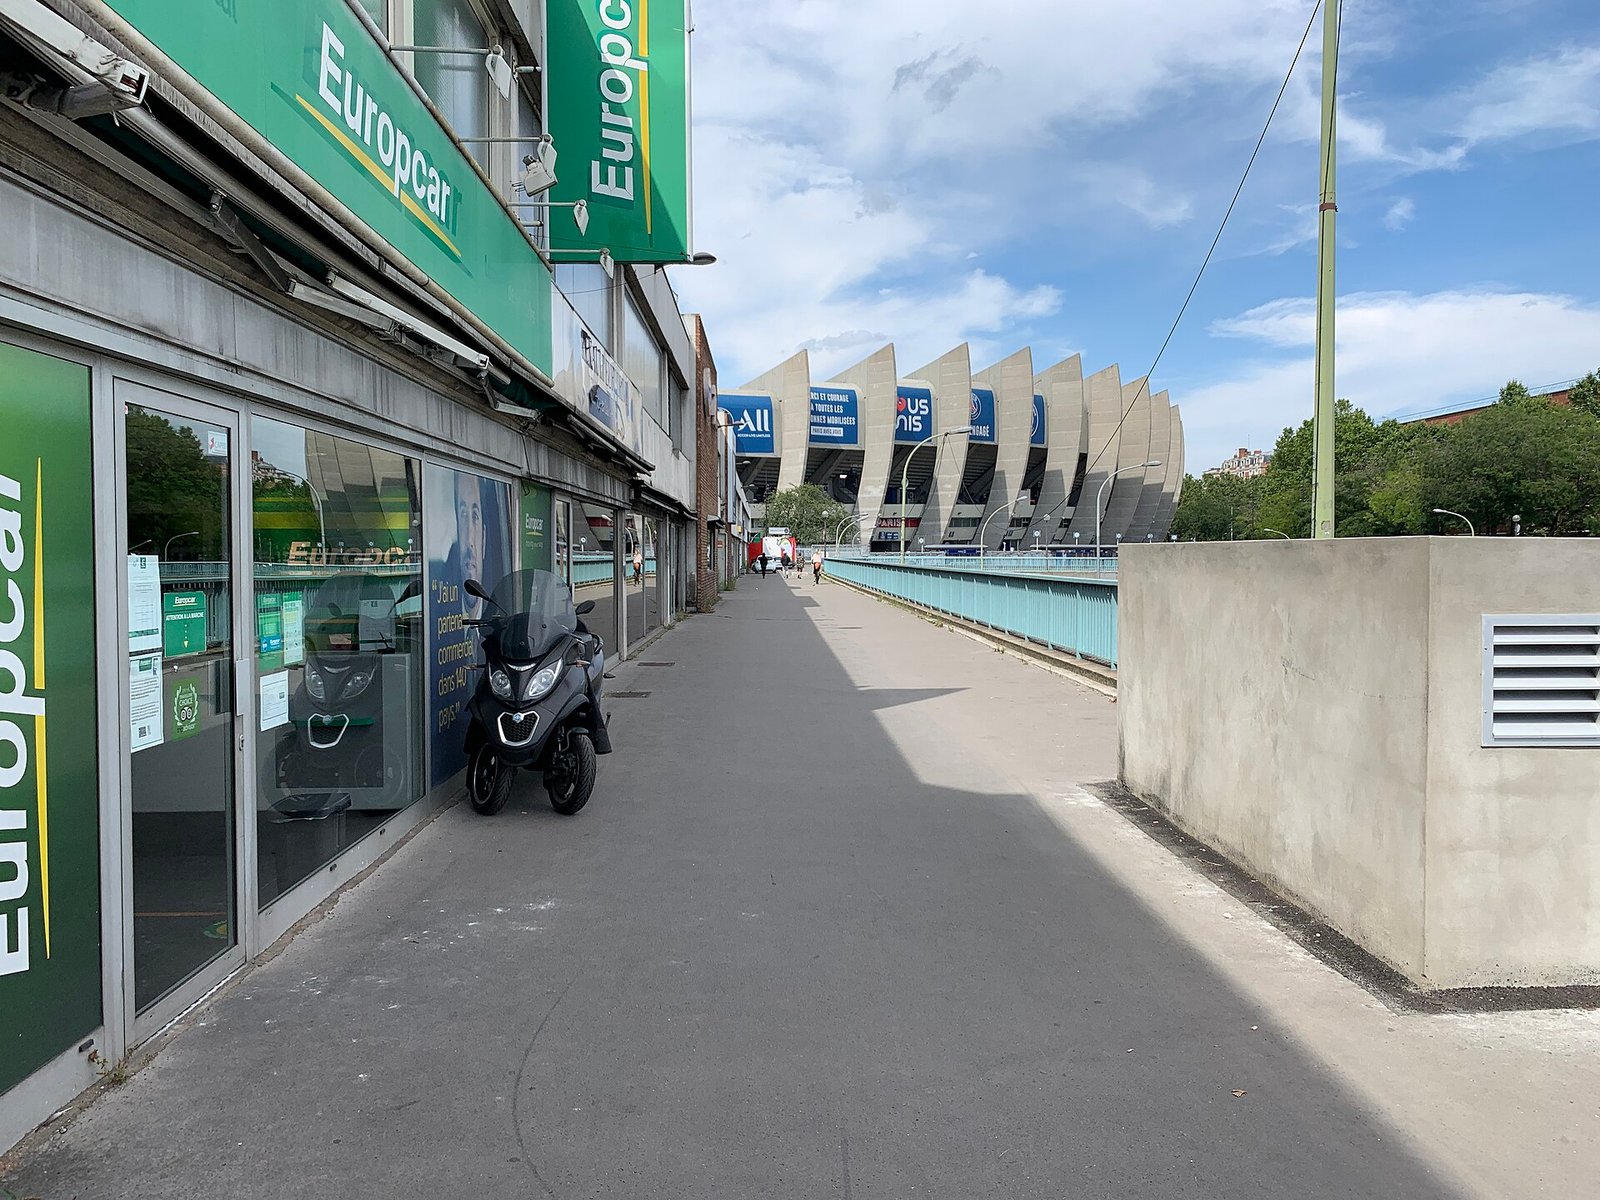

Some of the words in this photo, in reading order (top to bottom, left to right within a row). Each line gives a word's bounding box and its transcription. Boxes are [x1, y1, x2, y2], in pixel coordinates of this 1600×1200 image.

[319, 21, 451, 223] Europcar
[810, 391, 819, 400] RCI
[820, 393, 826, 401] ET
[827, 393, 849, 402] COURAGE
[815, 403, 833, 413] TOUTES
[834, 404, 844, 413] LES
[810, 414, 826, 424] ONNES
[896, 415, 923, 432] NIS
[450, 585, 459, 602] un
[438, 673, 455, 696] dans
[456, 666, 467, 688] 140
